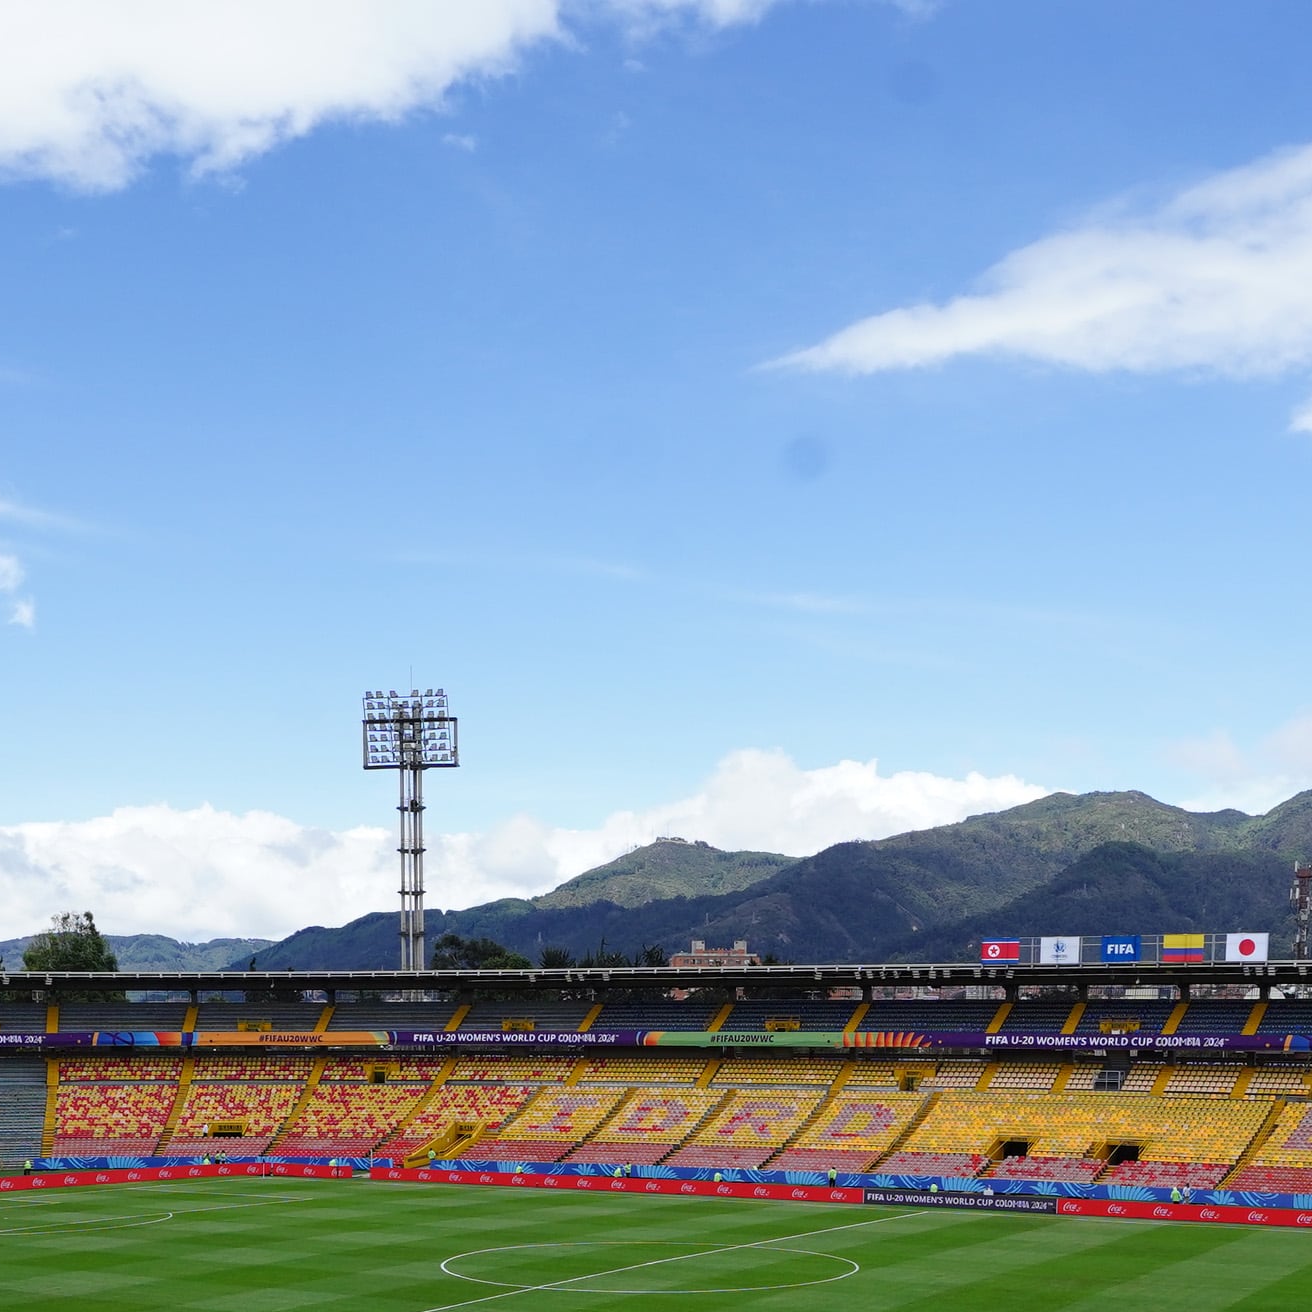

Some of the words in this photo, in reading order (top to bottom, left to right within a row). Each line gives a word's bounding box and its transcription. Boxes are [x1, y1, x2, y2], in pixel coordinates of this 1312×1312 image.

[1107, 944, 1134, 954] FIFA
[259, 1034, 323, 1043] #FIFAU20WWC
[413, 1033, 434, 1042] FIFA
[436, 1034, 456, 1042] U-20
[457, 1033, 500, 1042] WOMEN'S
[502, 1034, 536, 1042] WORLD
[538, 1034, 556, 1042] CUP
[710, 1034, 774, 1043] #FIFAU20WWC
[985, 1036, 1008, 1045] FIFA
[1011, 1036, 1034, 1045] U-20
[1036, 1037, 1087, 1046] WOMEN'S
[1089, 1037, 1128, 1046] WORLD
[1131, 1037, 1153, 1046] CUP
[867, 1193, 884, 1201] FIFA
[886, 1194, 903, 1202] U-20
[905, 1195, 943, 1204] WOMEN'S
[945, 1197, 975, 1206] WORLD
[976, 1198, 994, 1207] CUP
